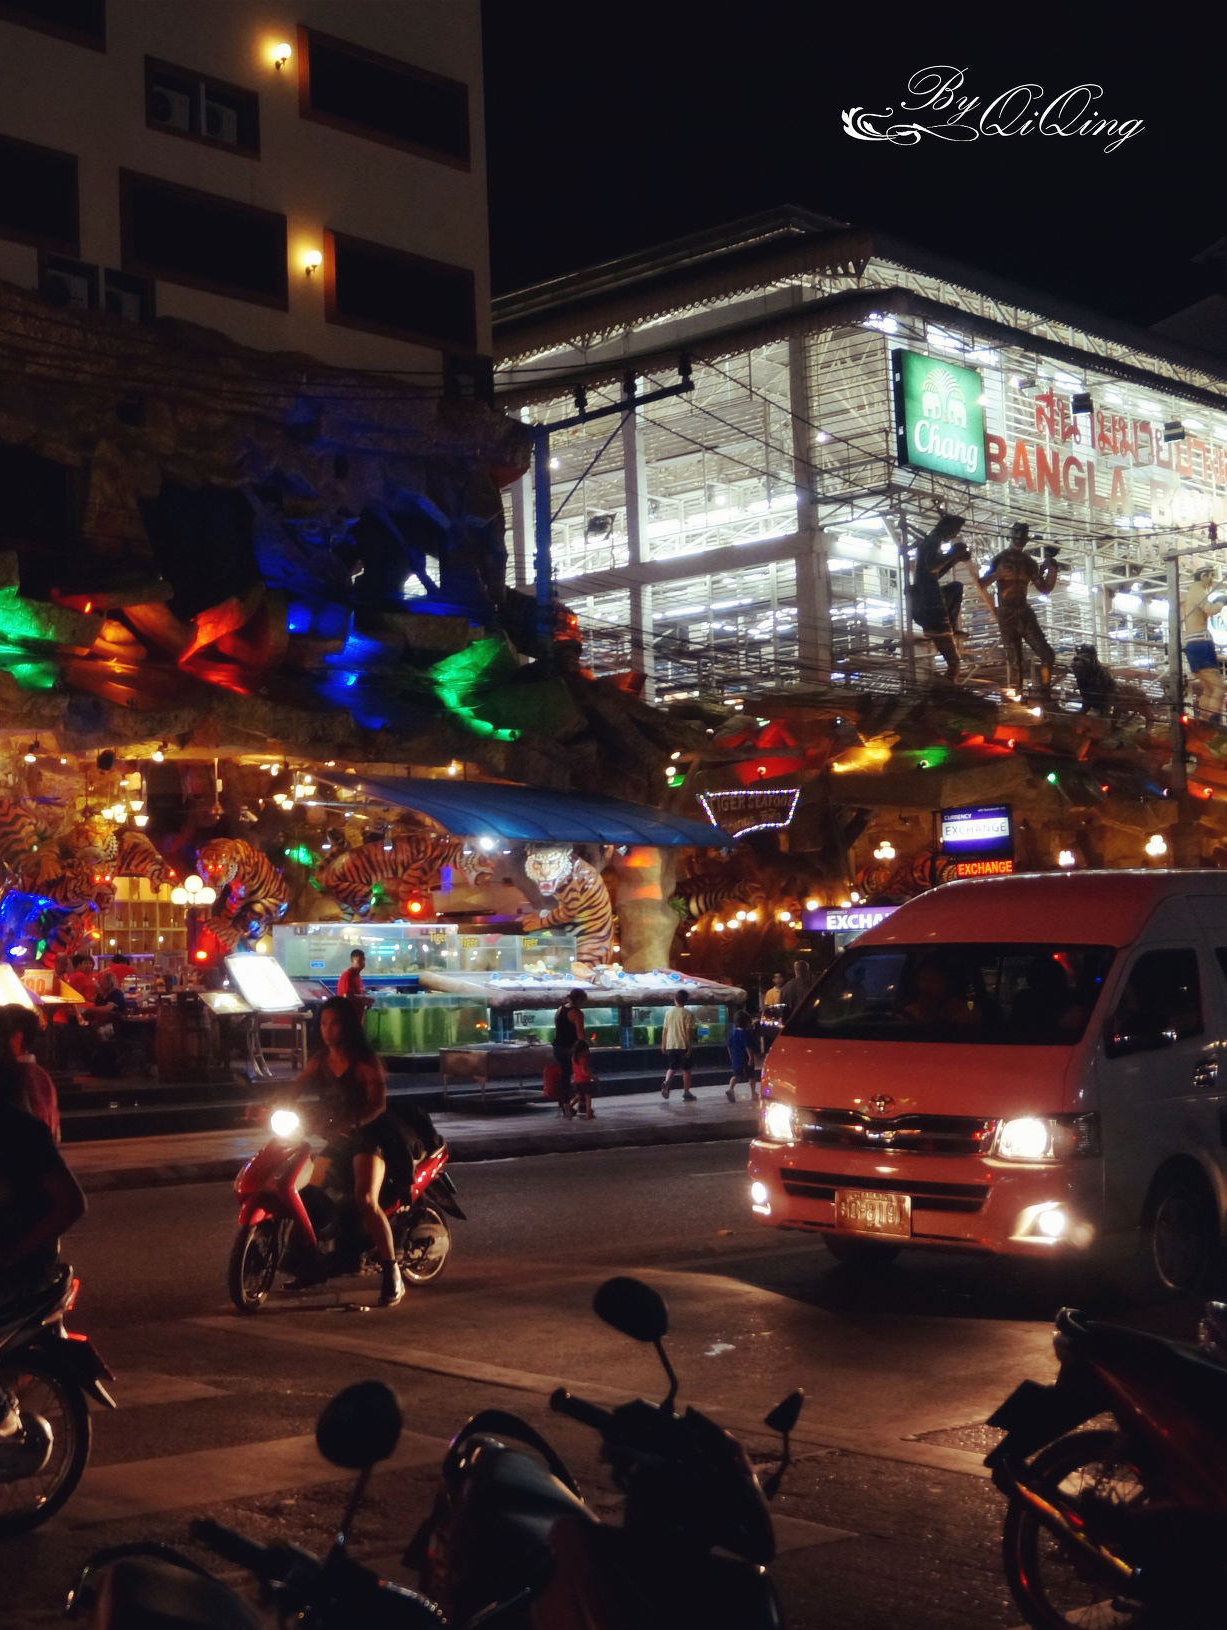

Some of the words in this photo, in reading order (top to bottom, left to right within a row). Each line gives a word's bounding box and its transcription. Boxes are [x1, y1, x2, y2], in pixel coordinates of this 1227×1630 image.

[914, 419, 979, 473] Chang
[986, 434, 1128, 513] BANGLA
[945, 822, 1007, 836] EXCHANGE
[957, 860, 1013, 875] EXCHANGE
